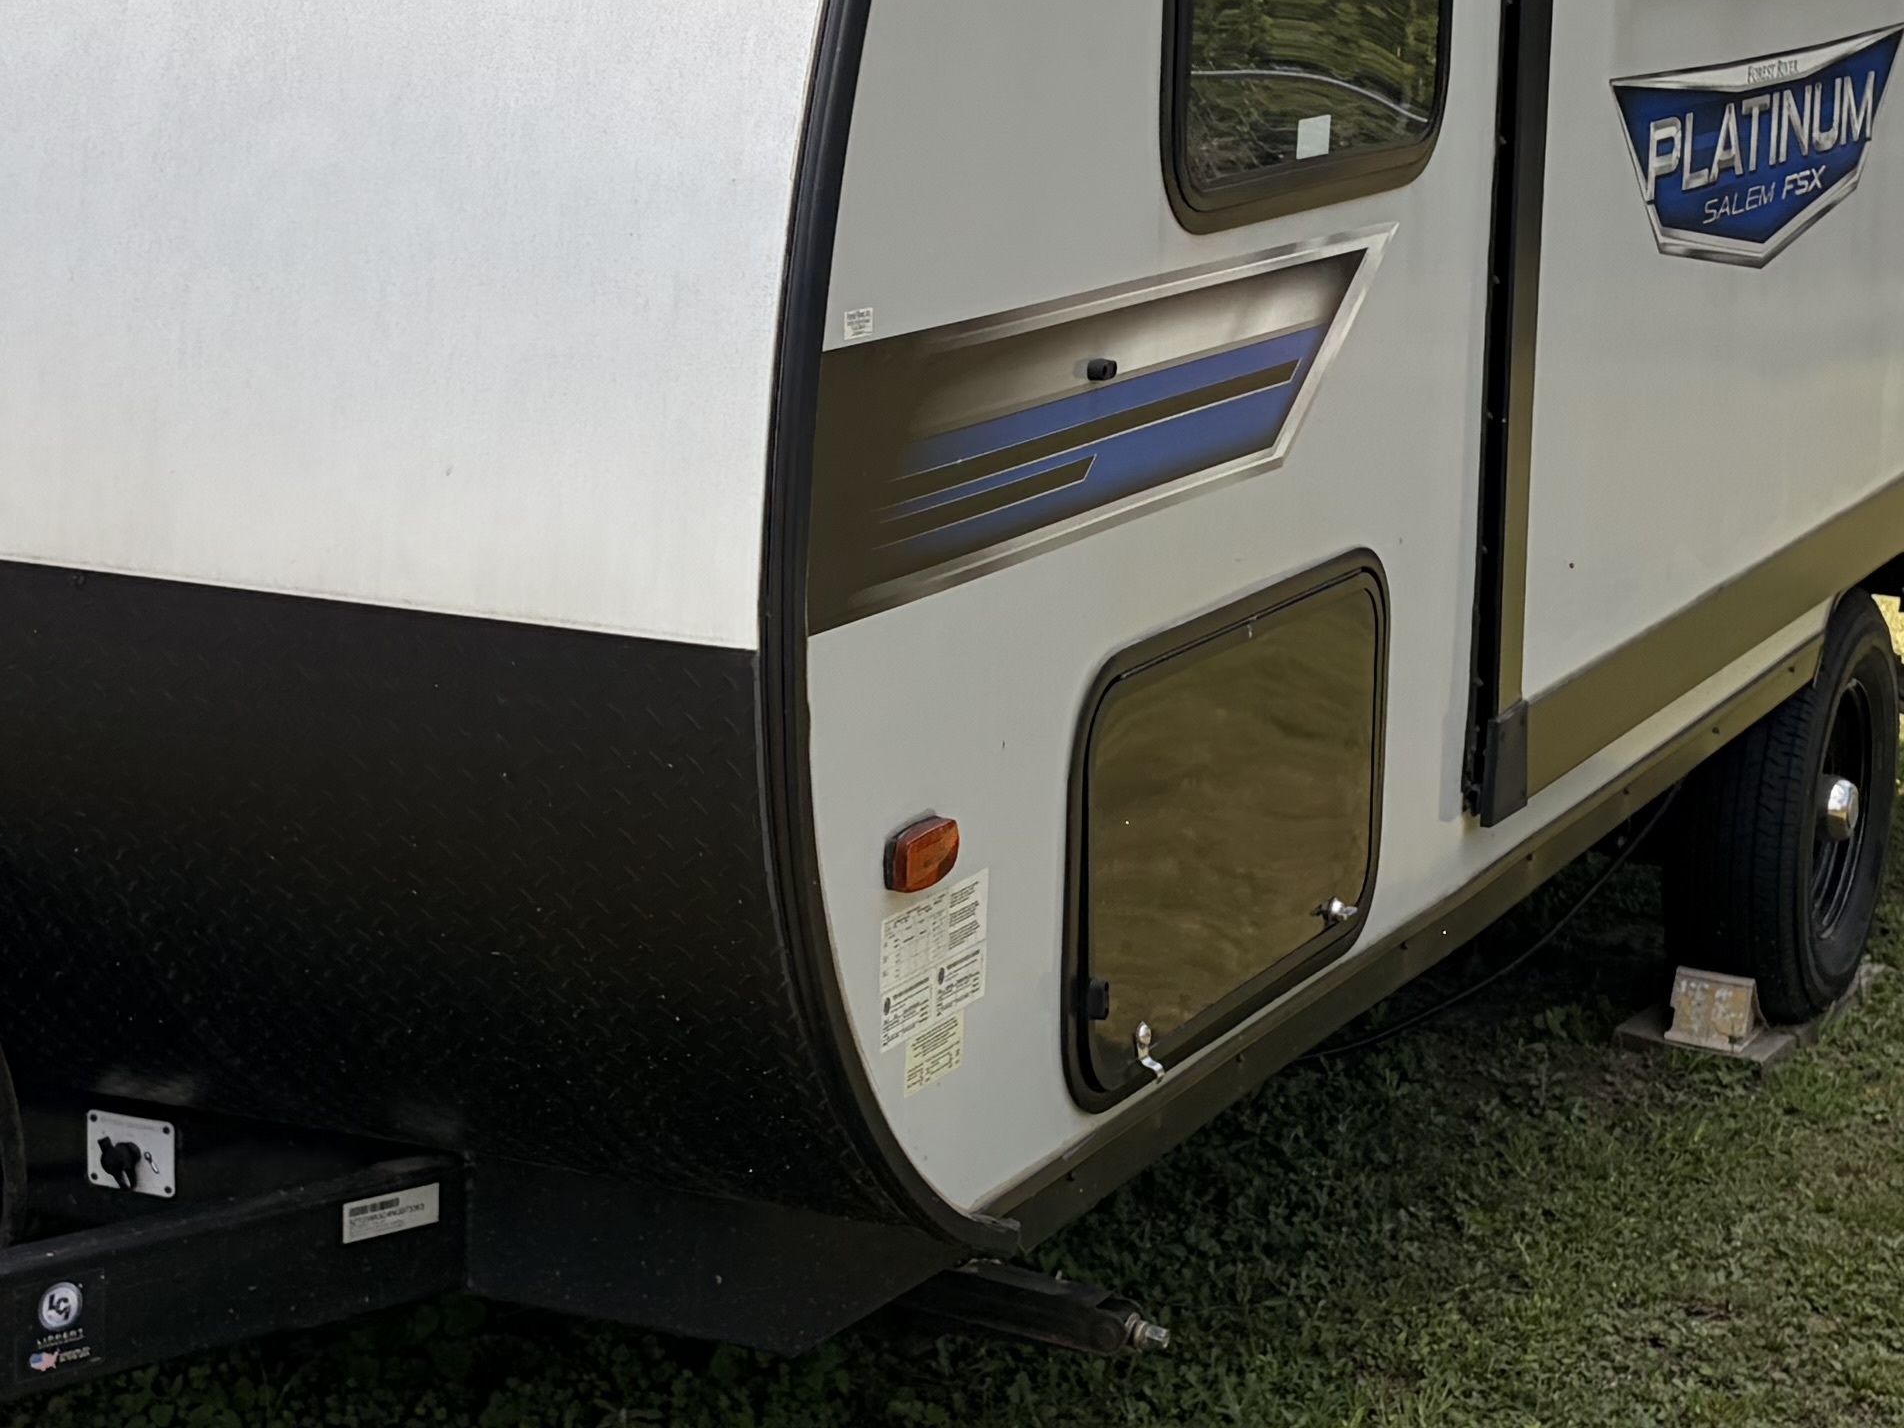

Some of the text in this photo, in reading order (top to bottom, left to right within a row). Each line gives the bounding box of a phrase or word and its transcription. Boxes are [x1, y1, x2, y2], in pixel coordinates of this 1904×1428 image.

[1646, 71, 1875, 203] PLATINUM
[1702, 165, 1826, 224] SALEM FSX
